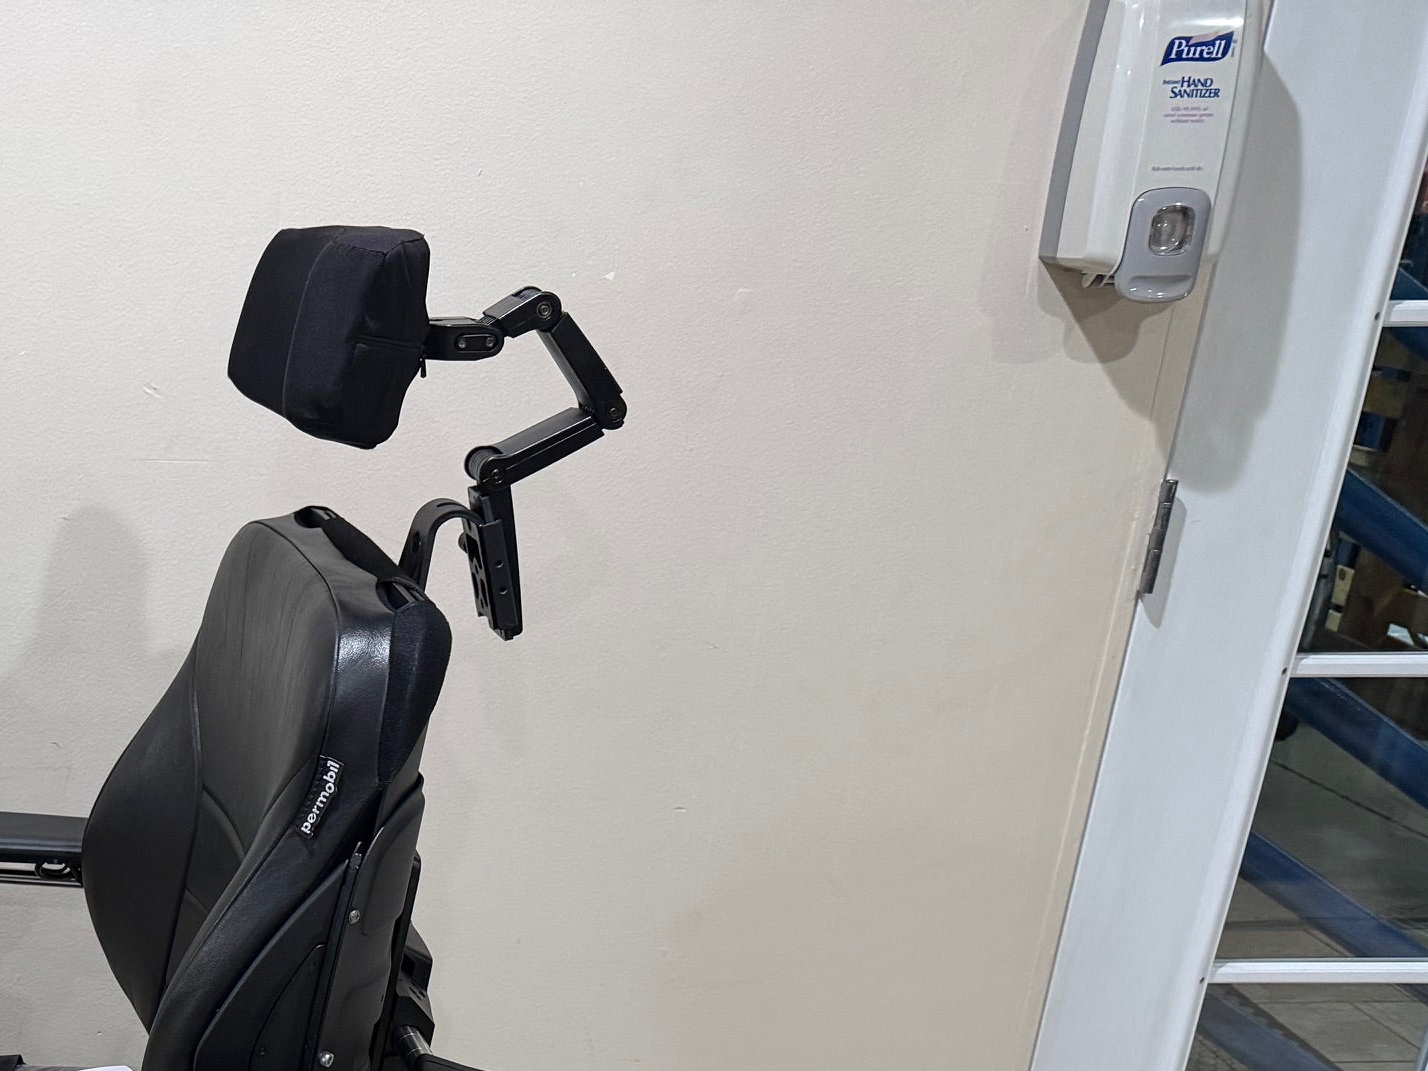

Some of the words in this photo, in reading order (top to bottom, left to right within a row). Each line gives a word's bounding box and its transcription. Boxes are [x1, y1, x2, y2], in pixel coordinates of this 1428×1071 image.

[1169, 39, 1227, 59] Purell
[1181, 76, 1214, 88] HAND
[1169, 86, 1221, 98] SANITIZER
[301, 760, 341, 834] permobil
